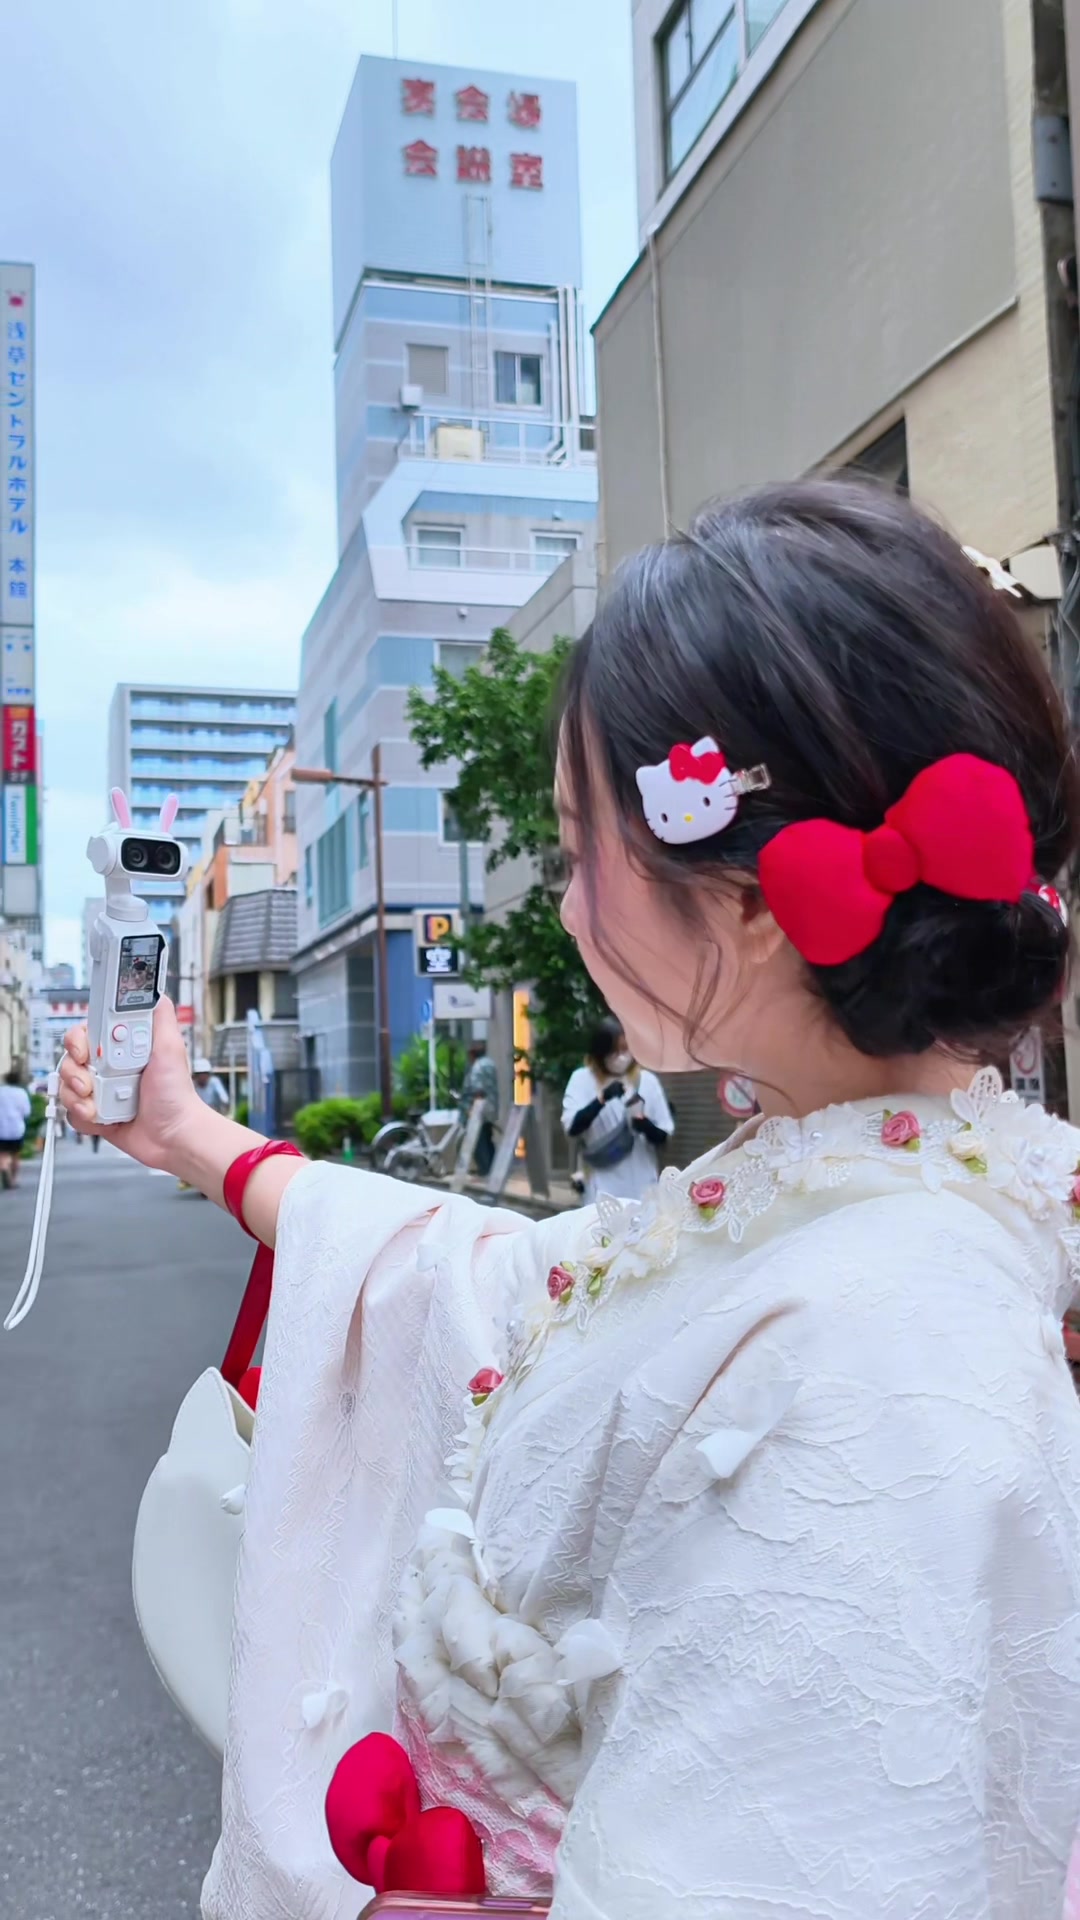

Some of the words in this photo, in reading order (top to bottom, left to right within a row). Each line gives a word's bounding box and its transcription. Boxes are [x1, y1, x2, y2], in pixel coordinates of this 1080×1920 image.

[403, 139, 543, 190] 会議室
[7, 321, 27, 535] 浅草セントラルホテル
[427, 915, 450, 939] P
